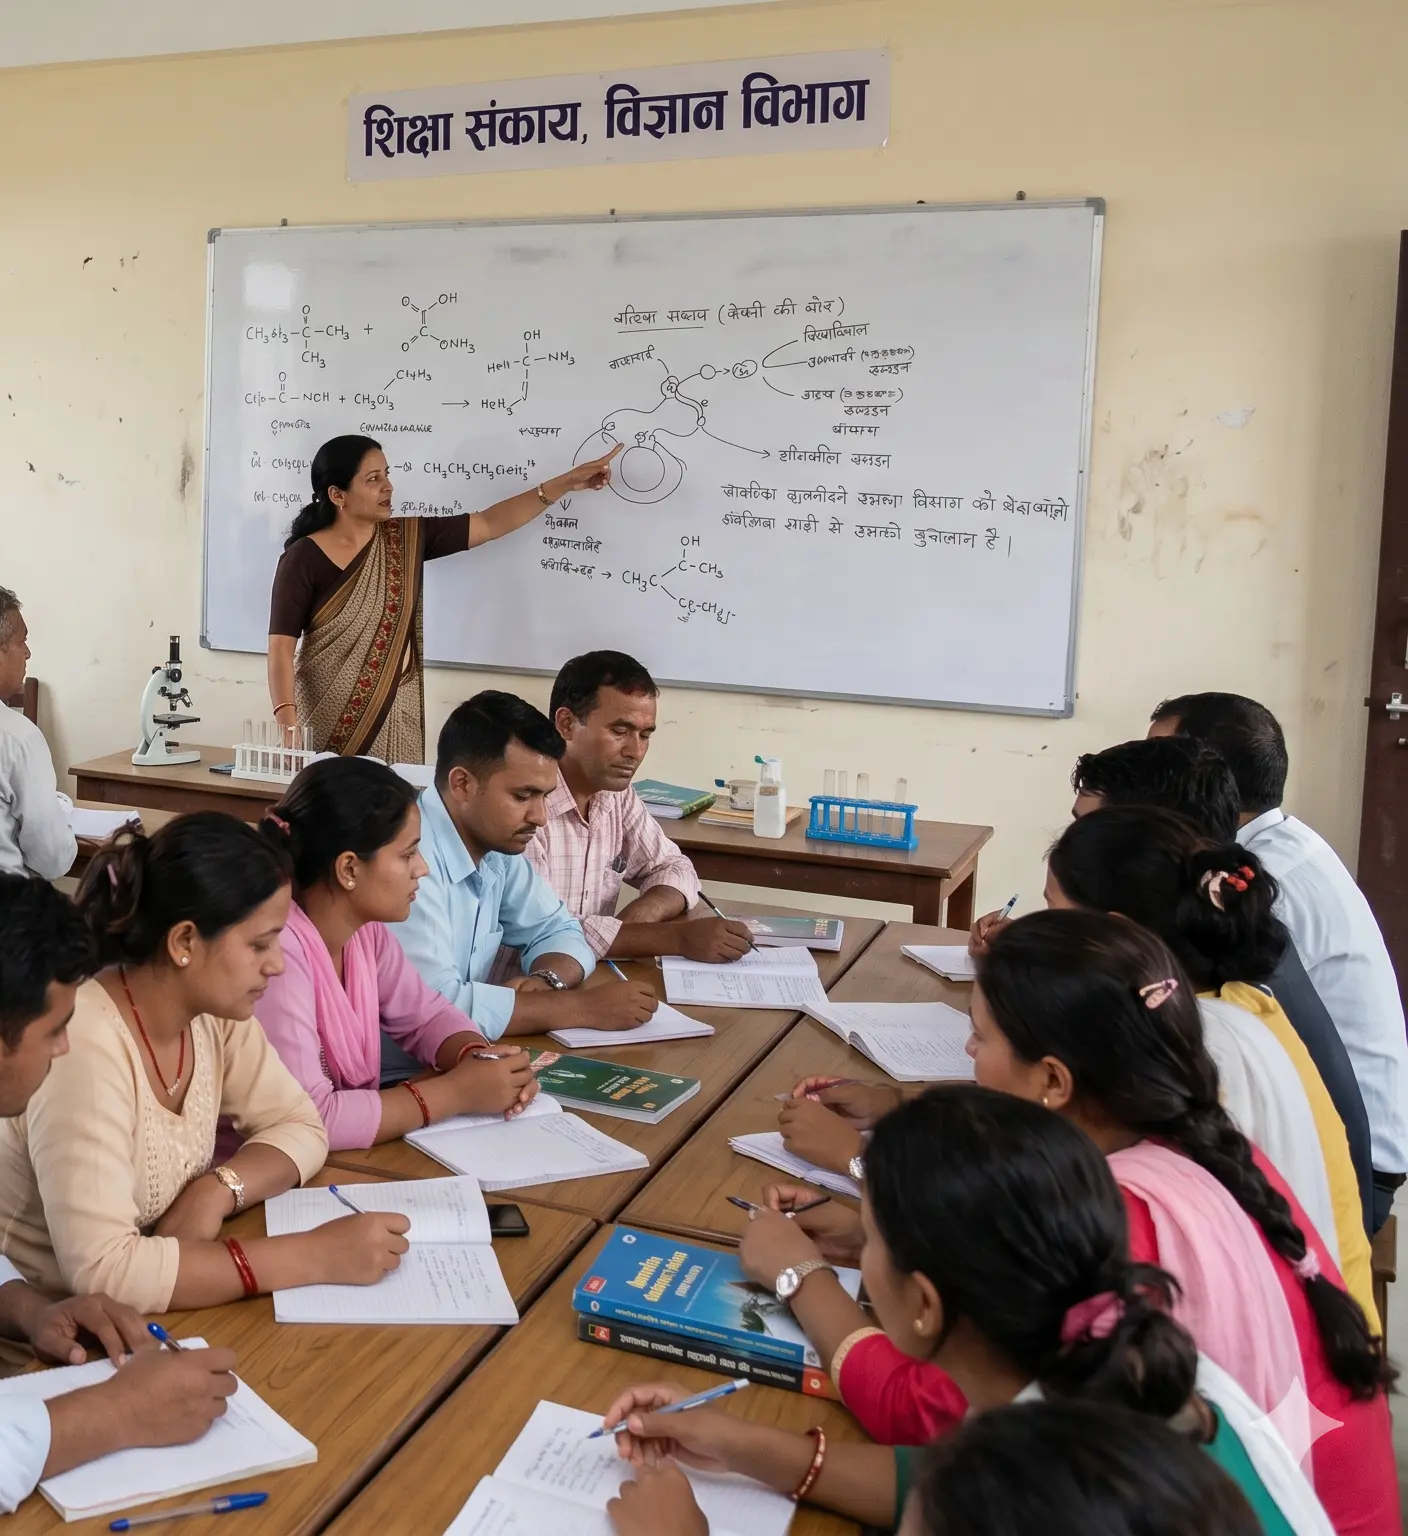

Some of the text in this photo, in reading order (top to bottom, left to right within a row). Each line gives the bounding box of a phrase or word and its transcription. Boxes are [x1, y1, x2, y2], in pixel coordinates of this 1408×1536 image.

[364, 72, 870, 159] शिक्षा संकाय, विज्ञान विभाग
